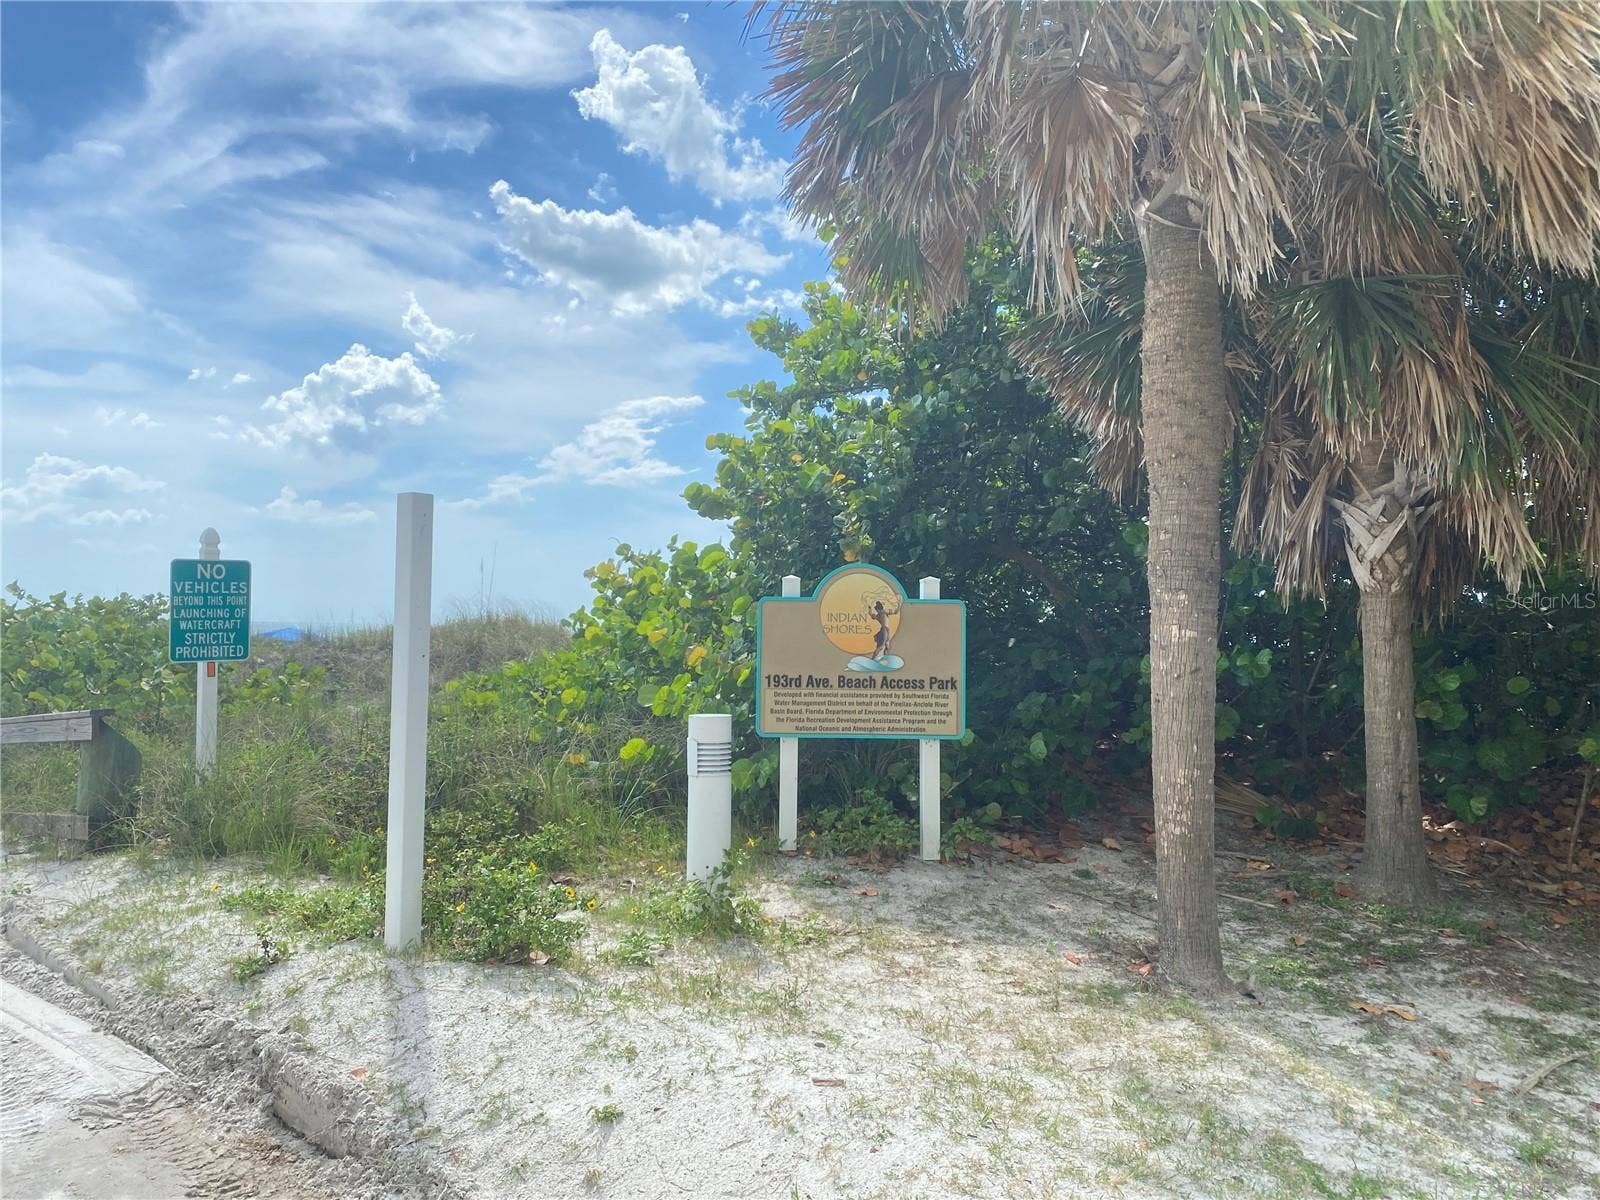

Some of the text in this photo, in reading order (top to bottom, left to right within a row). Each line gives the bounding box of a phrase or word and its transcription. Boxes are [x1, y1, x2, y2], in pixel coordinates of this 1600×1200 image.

[197, 564, 226, 579] NO
[174, 582, 247, 594] VEHICLES
[174, 596, 246, 606] BEYOND THIS POINT
[174, 608, 246, 618] LAUNCHING OF
[828, 612, 867, 622] INDIAN
[180, 620, 240, 630] WATERCRAFT
[823, 624, 872, 634] SHORES
[184, 632, 236, 644] STRICTLY
[176, 646, 244, 658] PROHIBITED
[765, 674, 957, 690] 193rd Ave. Beach Access Park
